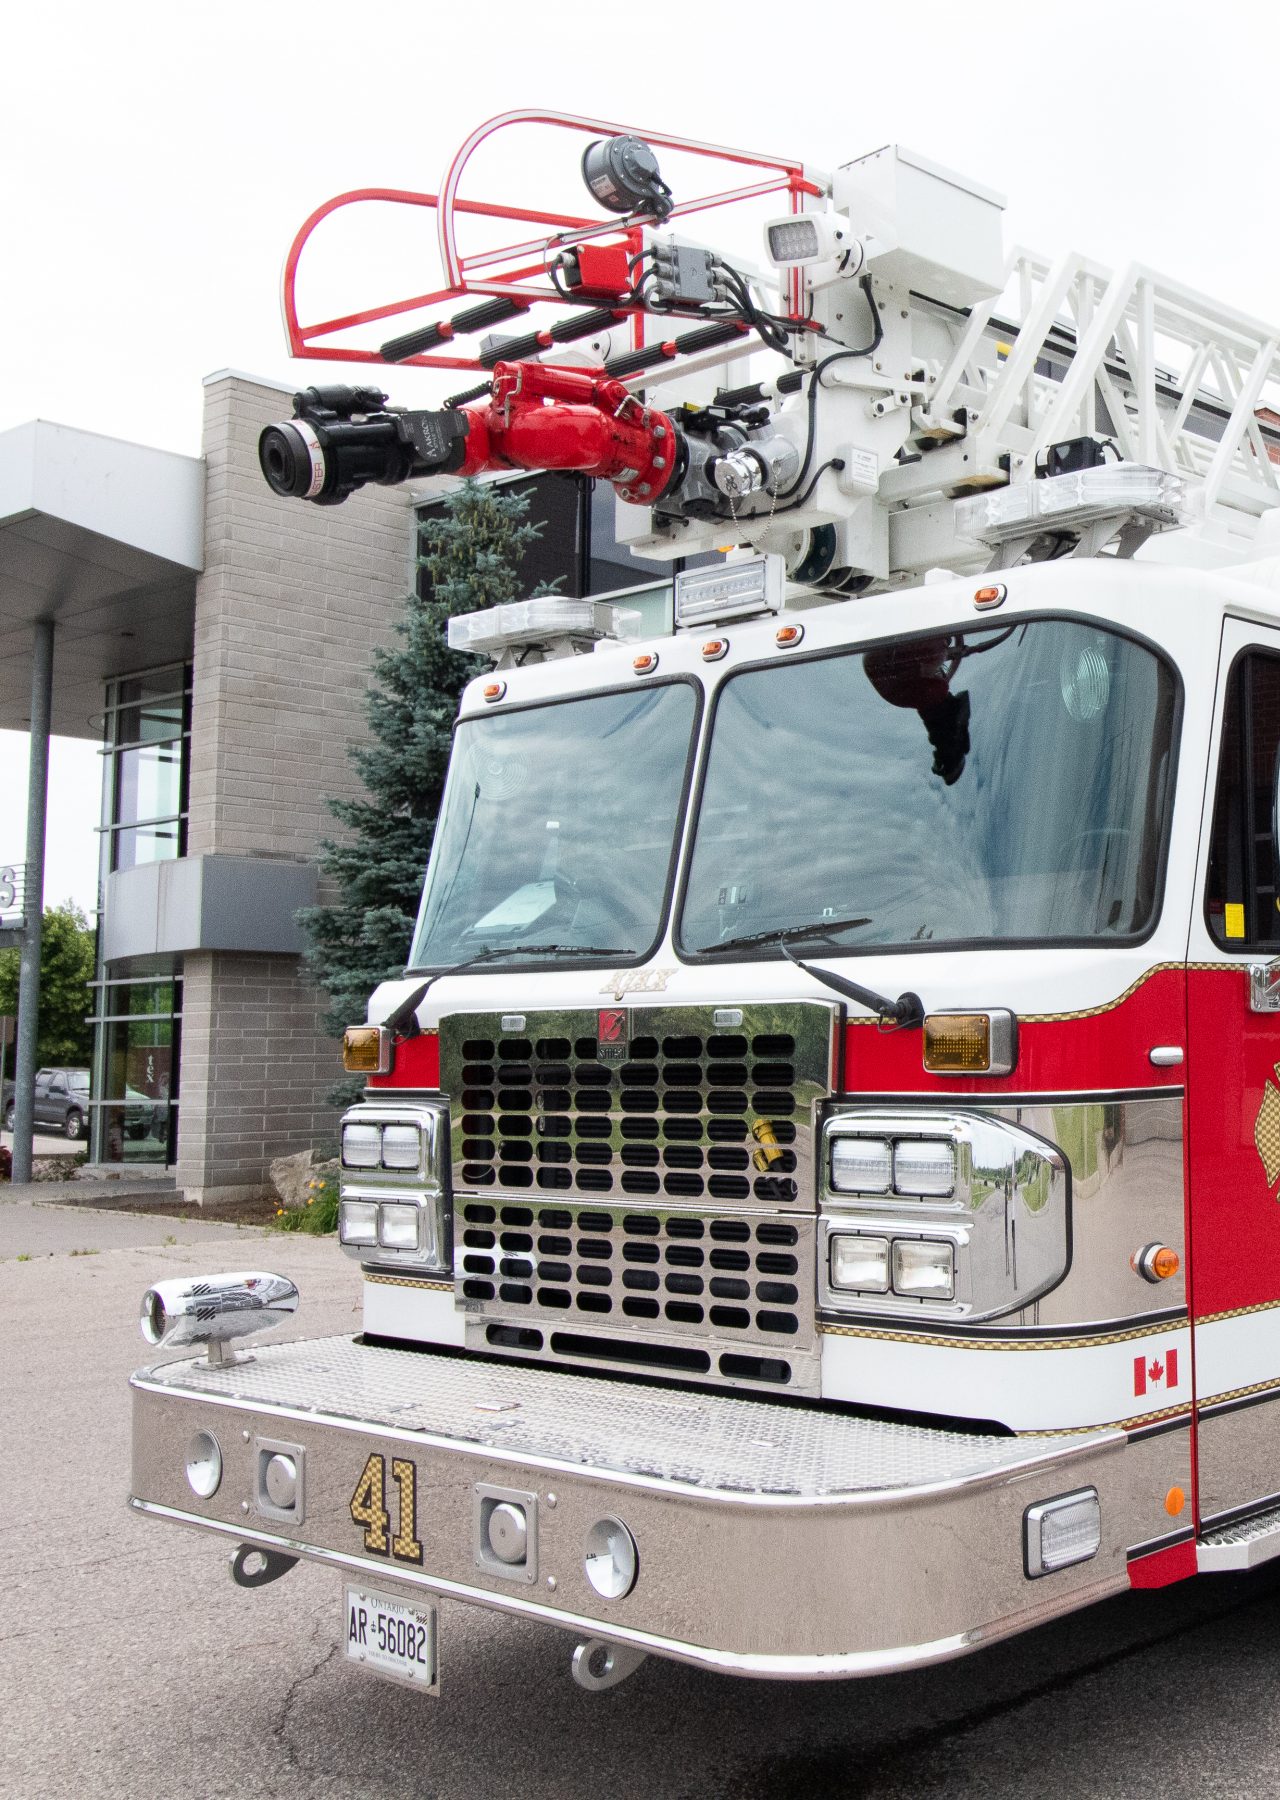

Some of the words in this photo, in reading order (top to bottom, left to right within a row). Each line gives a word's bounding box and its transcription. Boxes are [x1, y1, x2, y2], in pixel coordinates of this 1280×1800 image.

[349, 1452, 424, 1566] 41
[349, 1605, 367, 1646] AR
[377, 1612, 427, 1665] 56082
[370, 1597, 405, 1615] ONTARIO
